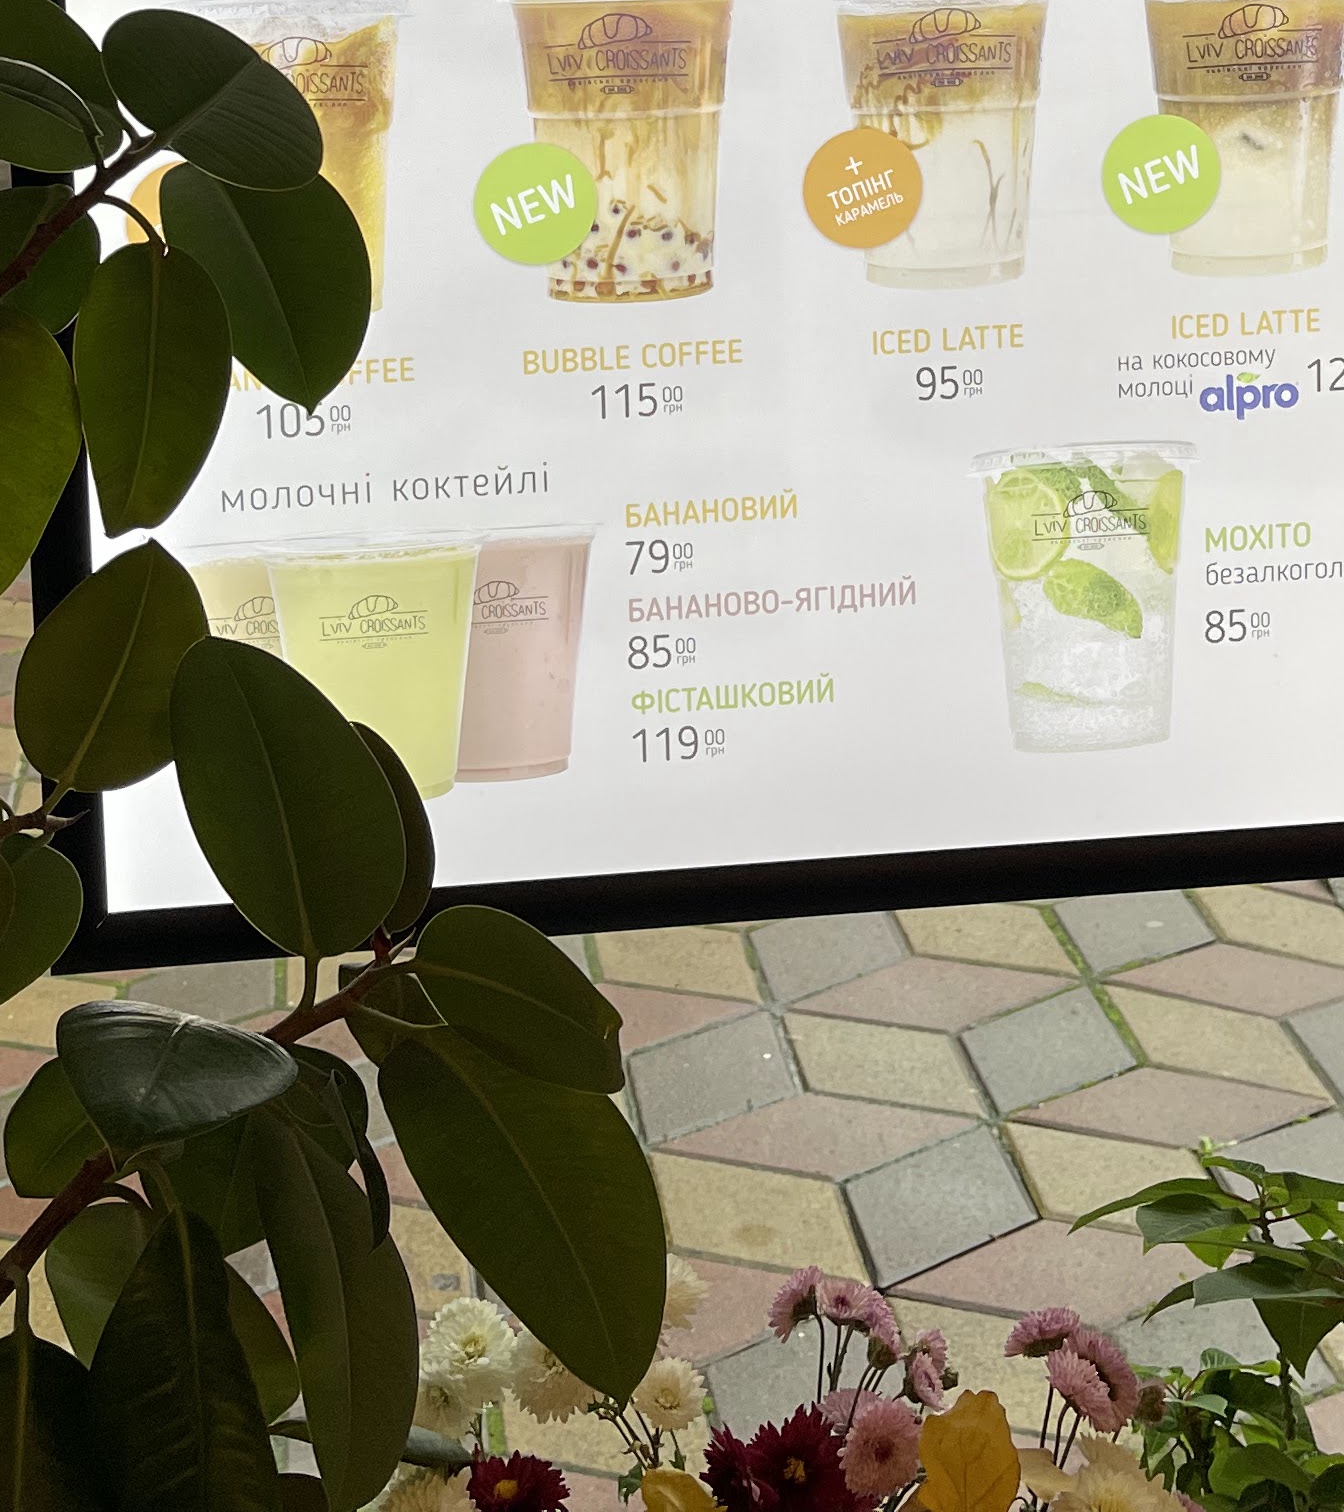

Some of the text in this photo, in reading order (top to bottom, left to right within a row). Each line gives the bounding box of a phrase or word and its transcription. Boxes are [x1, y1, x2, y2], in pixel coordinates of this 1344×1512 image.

[826, 169, 894, 209] ТОПІНГ
[1117, 144, 1199, 205] NEW
[490, 173, 575, 236] NEW
[834, 192, 905, 227] КАРАМЕЛЬ
[873, 324, 1023, 355] ICED LATTE
[1172, 308, 1320, 339] ICED LATTE
[339, 357, 415, 385] FFEE
[523, 339, 742, 375] BUBBLE COFFEE
[1118, 349, 1275, 371] на кокосовому
[1119, 376, 1192, 398] молоці
[1200, 374, 1299, 420] alpro
[222, 462, 547, 512] молочні коктейлі
[626, 489, 797, 528] БАНАНОВИЙ
[1205, 522, 1311, 553] МОХІТО
[629, 575, 916, 622] БАНАНОВО-ЯГІДНИЙ
[632, 673, 834, 714] ФІСТАШКОВИЙ
